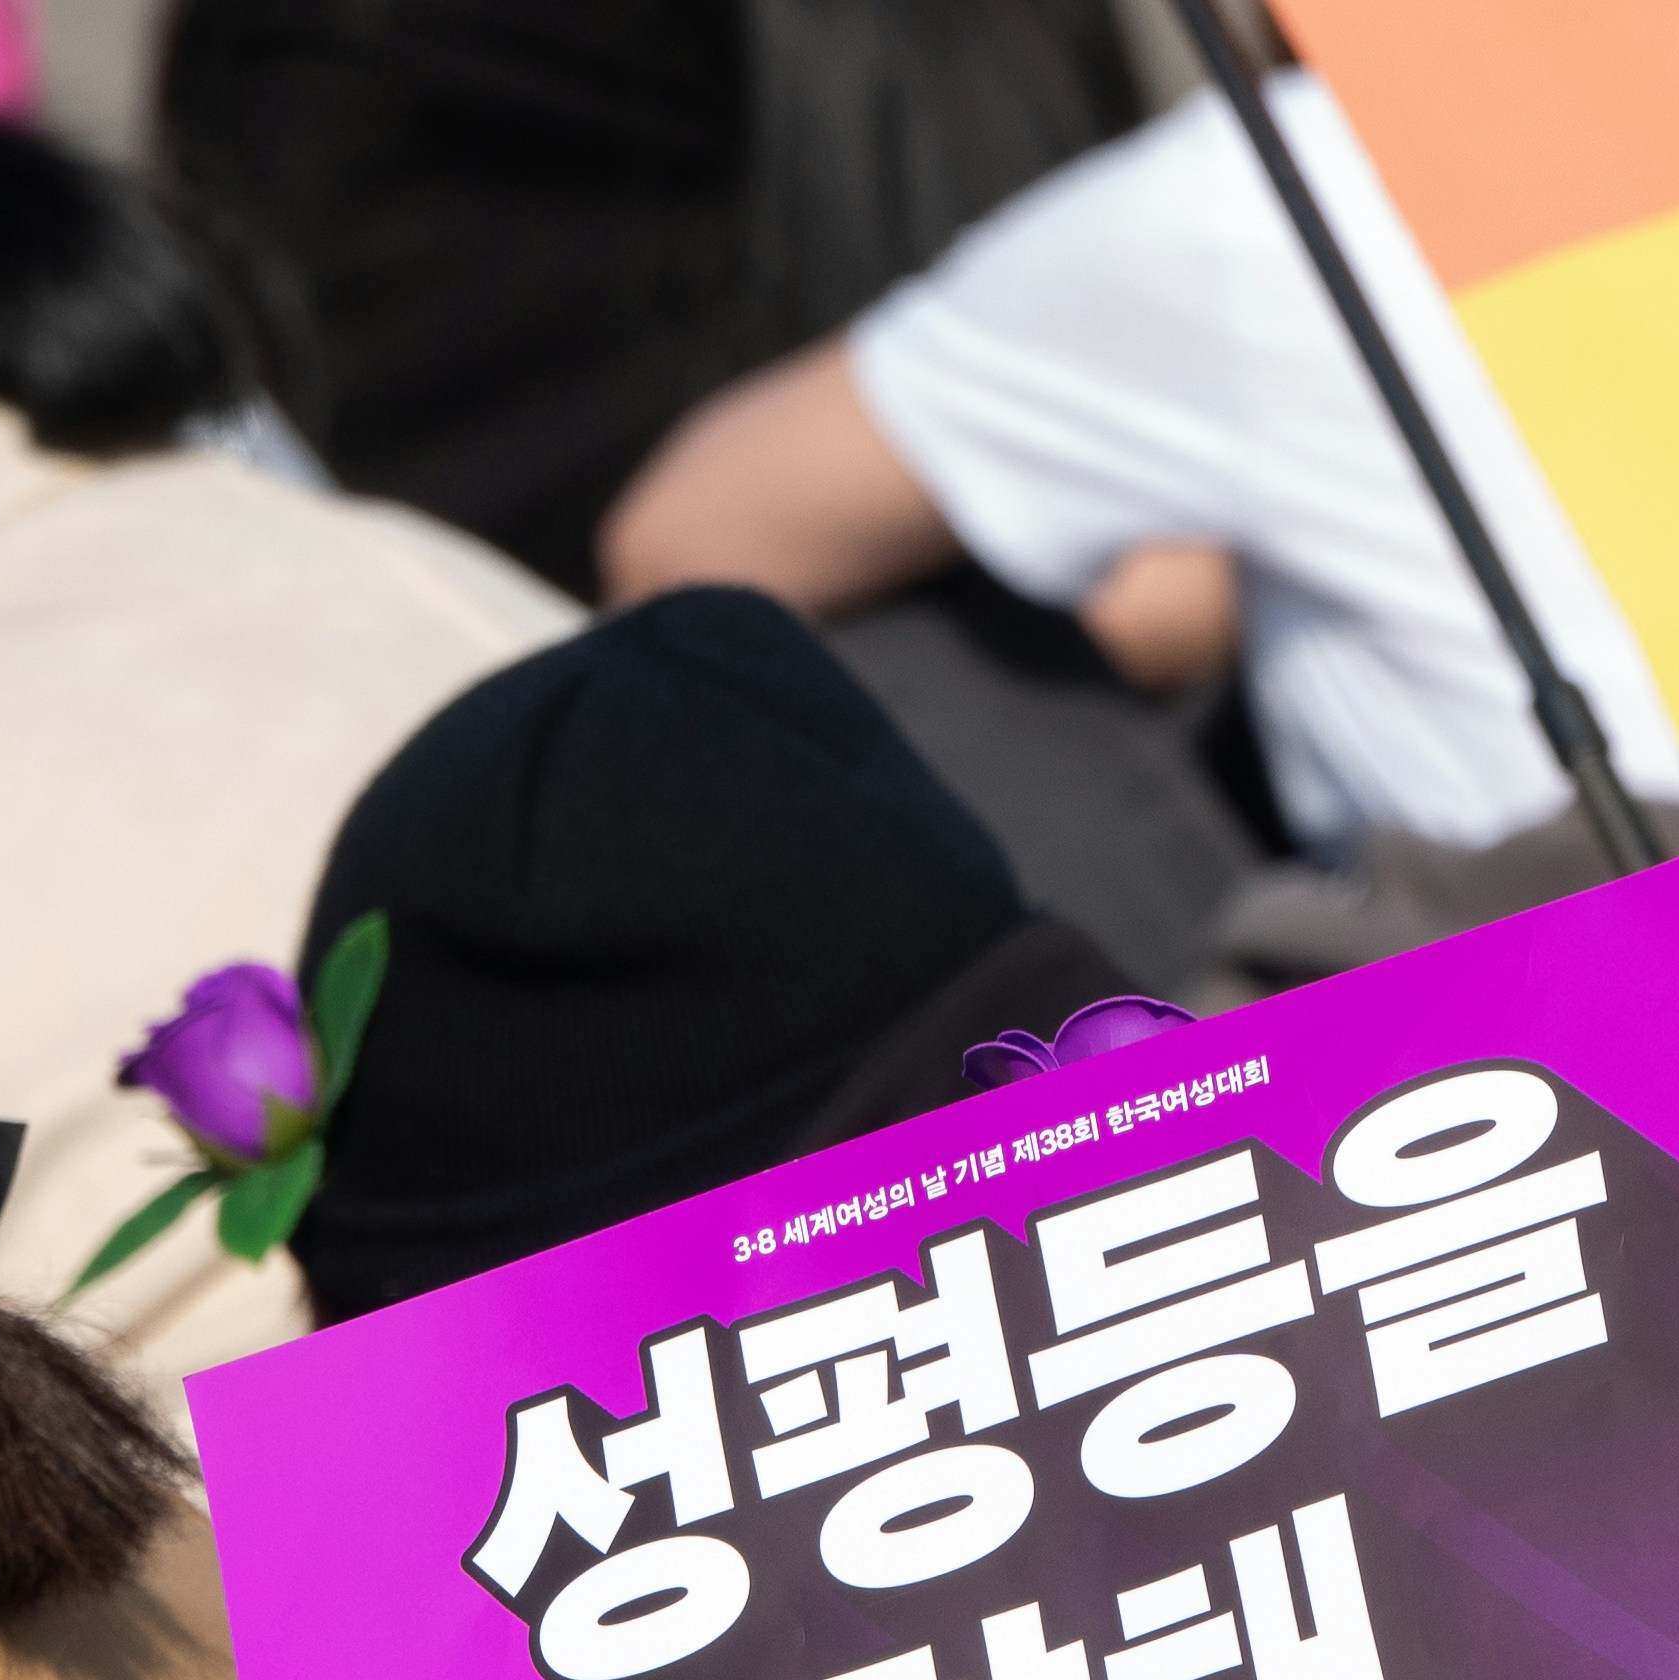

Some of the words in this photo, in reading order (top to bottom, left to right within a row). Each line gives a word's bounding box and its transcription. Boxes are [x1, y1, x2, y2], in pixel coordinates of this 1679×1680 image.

[781, 1175, 916, 1246] 세계여성의
[919, 1164, 949, 1202] 날
[951, 1142, 1008, 1186] 기념
[1010, 1110, 1101, 1164] 제38회
[1104, 1054, 1271, 1136] 한국여성대회
